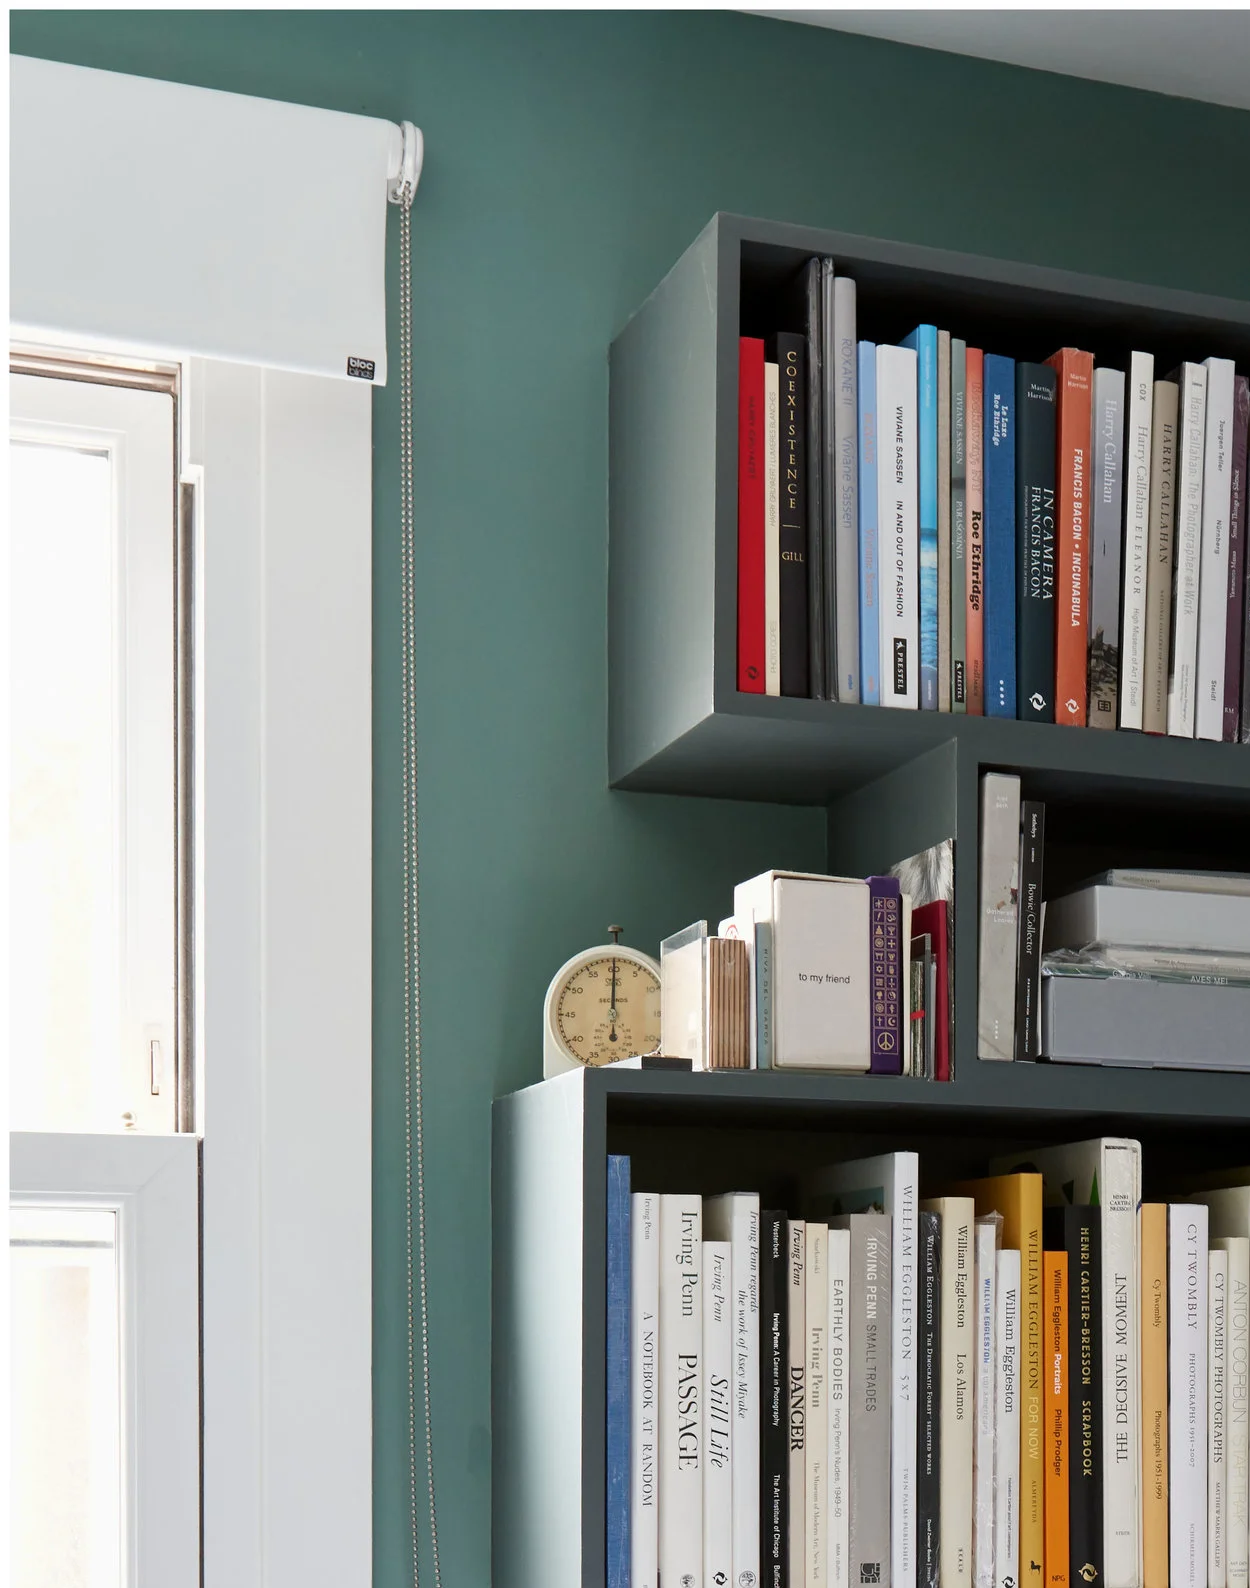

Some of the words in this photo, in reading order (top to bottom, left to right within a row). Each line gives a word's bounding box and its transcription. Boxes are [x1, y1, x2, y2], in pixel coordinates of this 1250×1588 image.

[349, 358, 373, 370] bloc
[786, 351, 798, 510] COEXISTENCE
[1102, 398, 1117, 439] Harry
[1072, 448, 1083, 499] FRANCIS
[1103, 442, 1116, 504] Callahan
[896, 501, 903, 510] IN
[1030, 486, 1042, 546] FRANCIS
[1043, 487, 1054, 509] IN
[1072, 503, 1083, 540] BACON
[782, 551, 804, 562] GILL
[896, 559, 903, 572] OF
[1030, 549, 1041, 598] BACON
[1041, 516, 1054, 601] CAMERA
[1071, 552, 1082, 627] INCUNABULA
[897, 652, 905, 689] PRESTEL
[1026, 883, 1036, 954] Bowie/Collector
[799, 973, 807, 981] to
[810, 975, 823, 983] my
[826, 973, 850, 984] friend
[676, 1212, 698, 1265] Irving
[791, 1227, 803, 1259] Irving
[957, 1225, 969, 1269] William
[1080, 1227, 1091, 1265] HENRI
[711, 1254, 725, 1291] Irving
[793, 1262, 803, 1286] Penn
[680, 1273, 697, 1317] Penn
[713, 1294, 724, 1322] Penn
[954, 1272, 967, 1328] Eggleston
[1004, 1289, 1016, 1341] William
[956, 1354, 967, 1374] Los
[1002, 1345, 1016, 1413] Eggleston
[677, 1353, 698, 1470] PASSAGE
[709, 1374, 729, 1422] Still
[790, 1366, 804, 1451] DANCER
[955, 1377, 967, 1420] Alamos
[709, 1429, 728, 1468] Life
[1081, 1400, 1092, 1477] SCRAPBOOK
